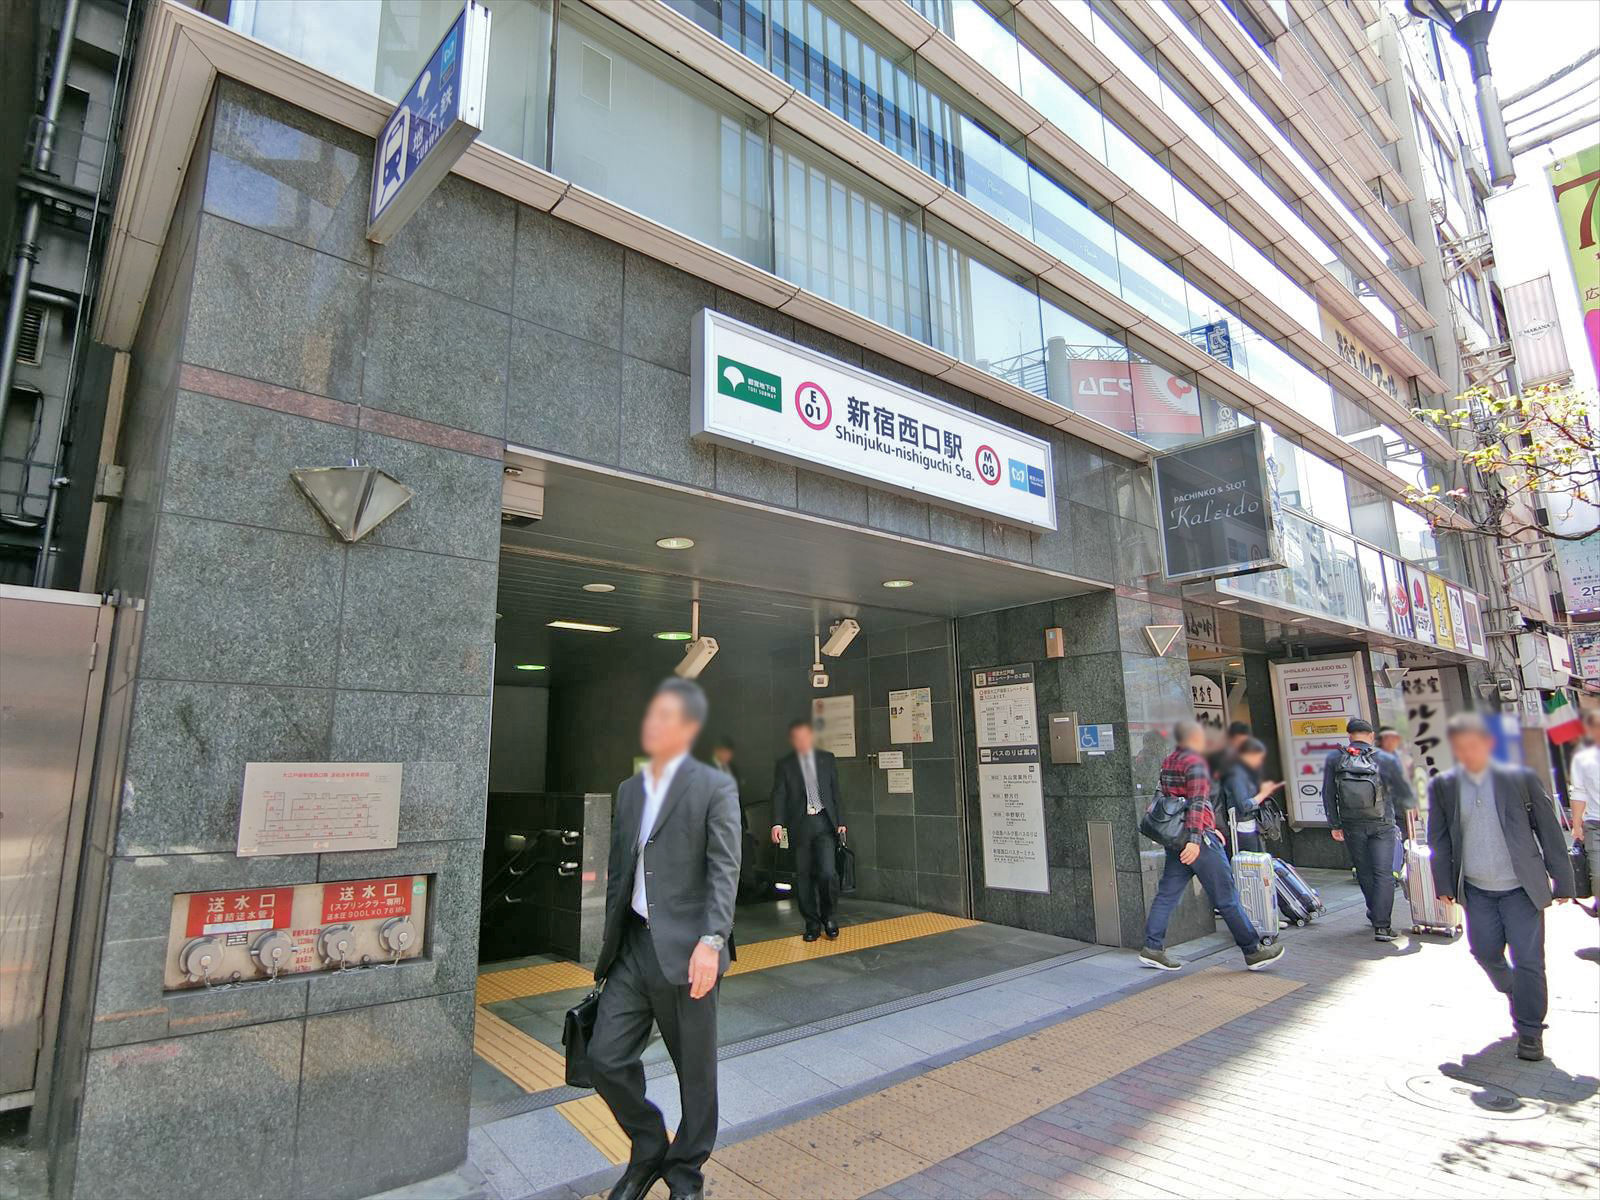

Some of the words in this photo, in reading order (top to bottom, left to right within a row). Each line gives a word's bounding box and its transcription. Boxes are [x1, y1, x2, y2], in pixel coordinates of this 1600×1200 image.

[412, 85, 453, 153] 地下鉄
[416, 118, 445, 165] SUBWAY
[811, 390, 817, 403] E
[805, 403, 820, 420] 01
[847, 396, 963, 462] 新宿西口駅
[835, 424, 952, 474] Shinjuku-nishiguchi
[955, 464, 976, 482] Sta.
[983, 452, 992, 463] M
[982, 463, 995, 477] 08
[1173, 488, 1216, 504] PACHINKO
[1225, 480, 1246, 492] SLOT
[1168, 492, 1259, 530] Kaleido
[992, 748, 1037, 758] バスのりば案内
[338, 883, 398, 901] 送水口
[208, 893, 276, 913] 送水口
